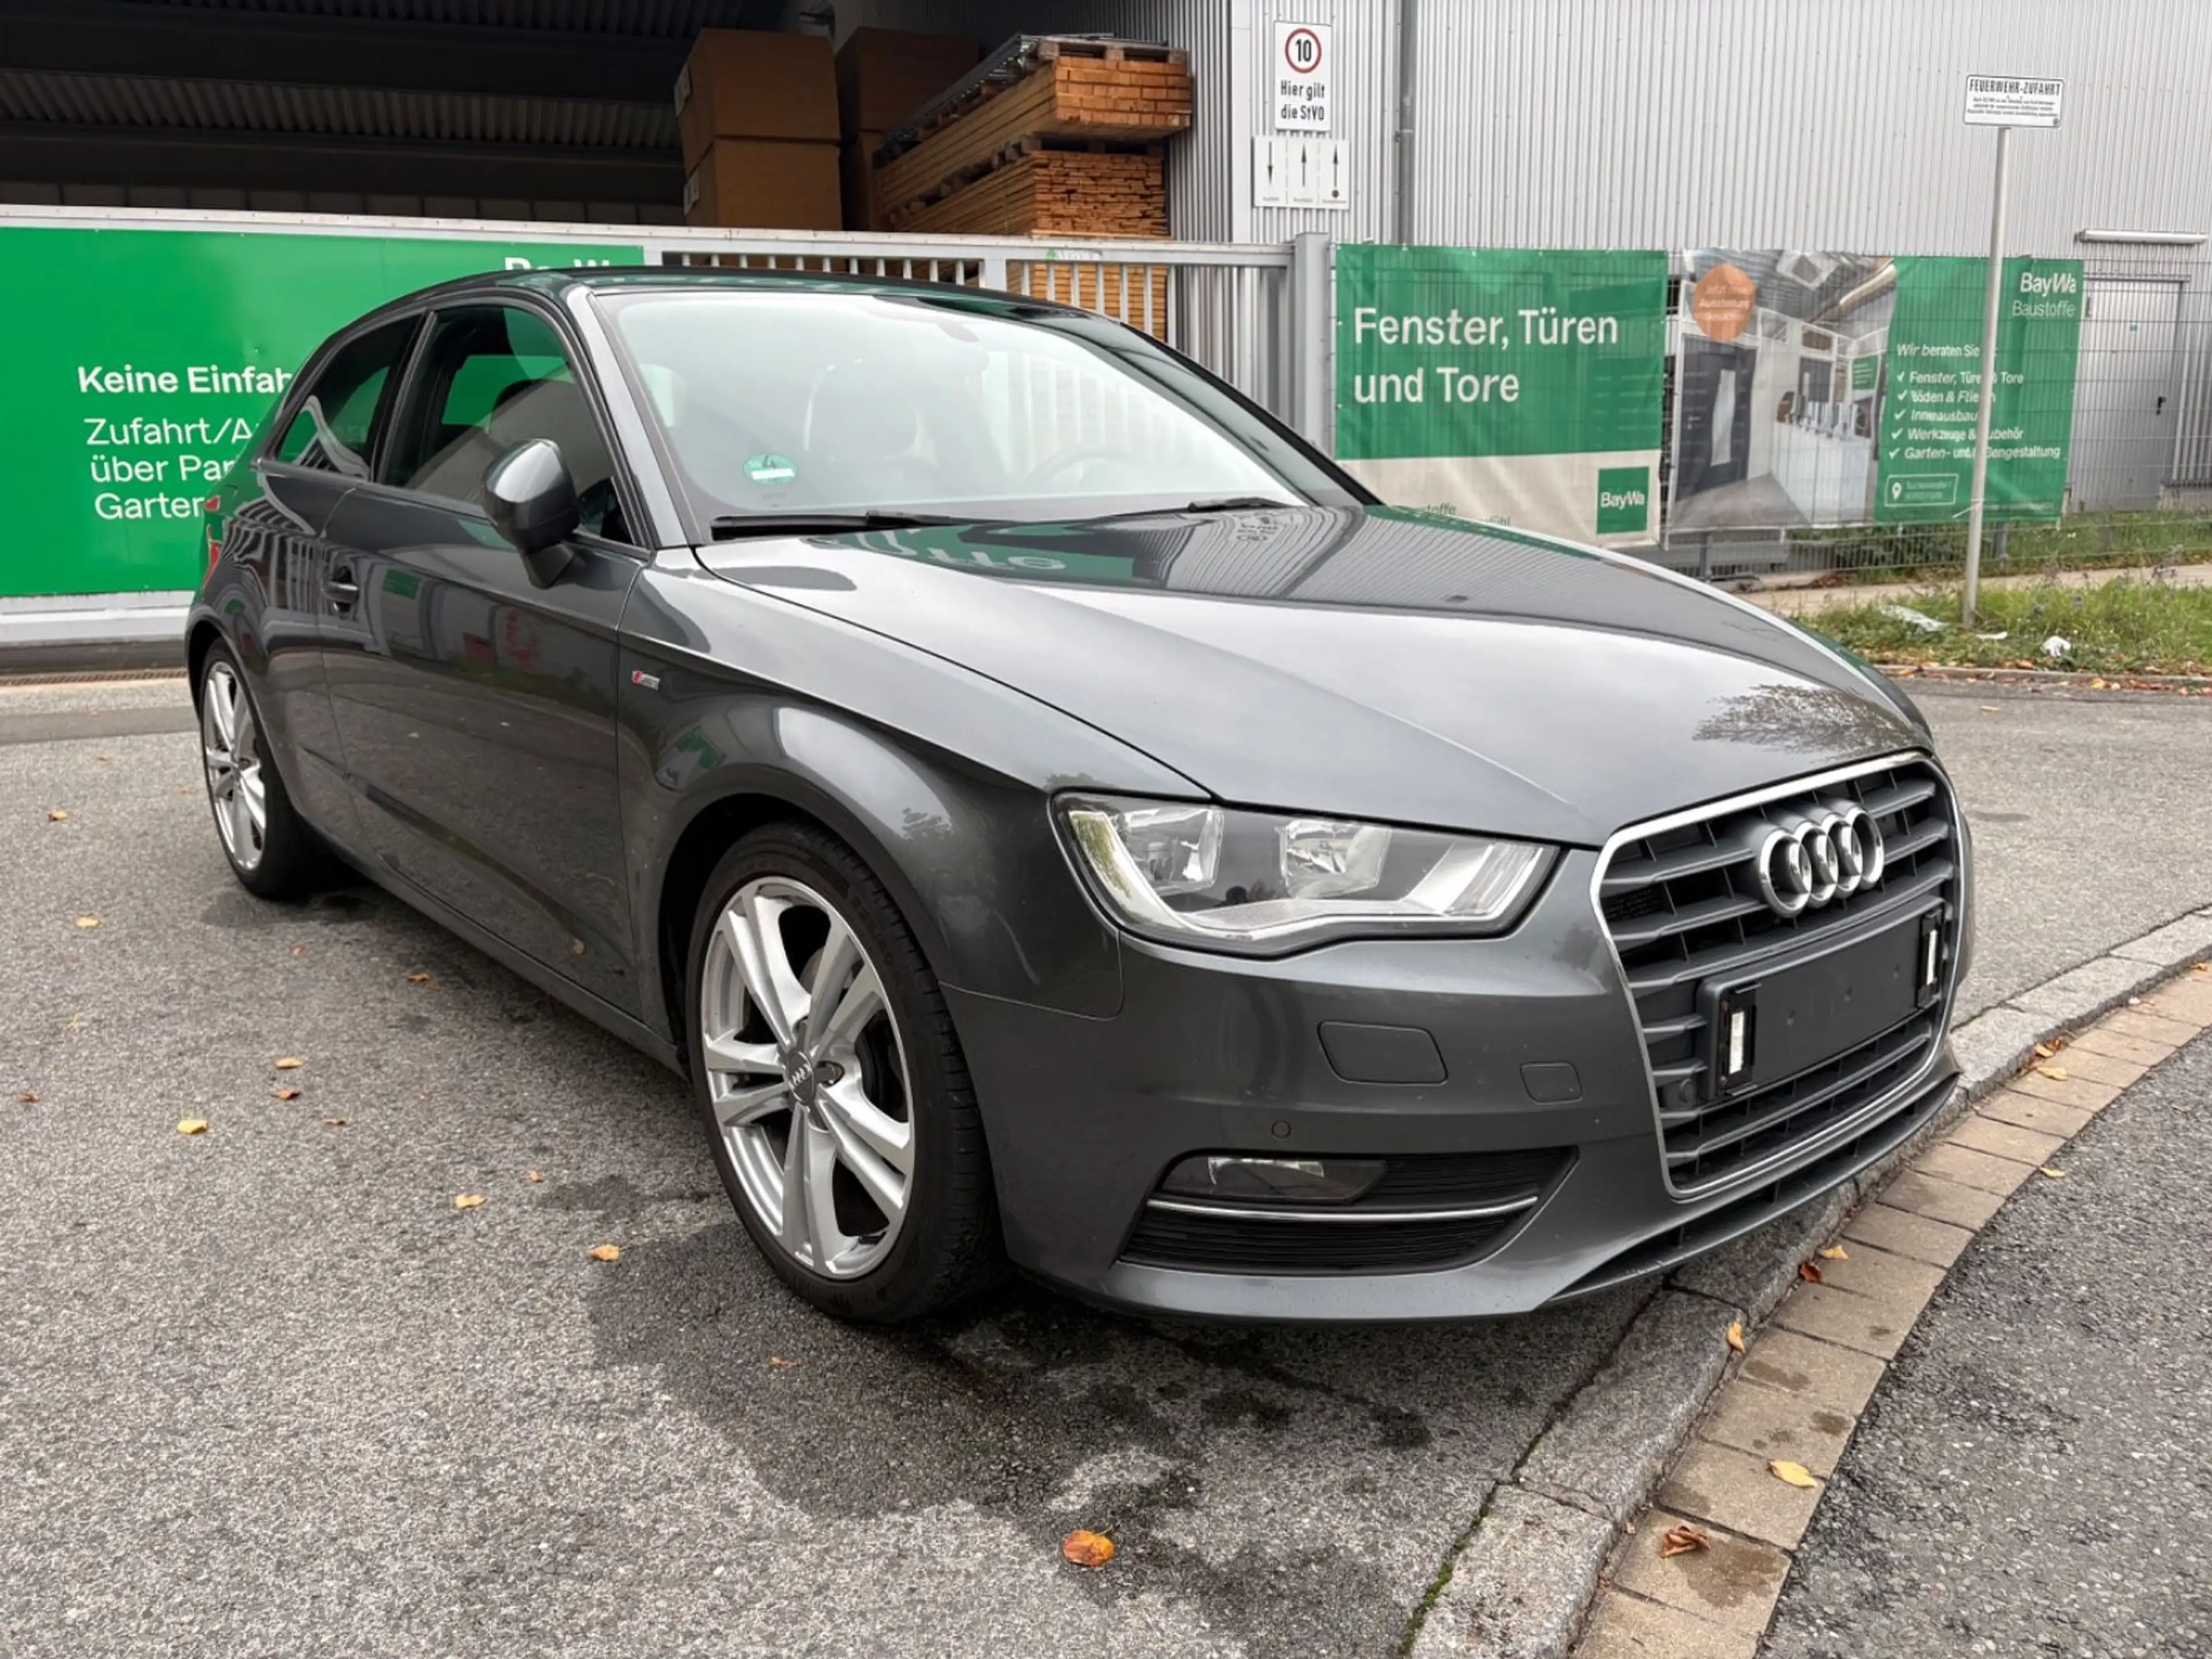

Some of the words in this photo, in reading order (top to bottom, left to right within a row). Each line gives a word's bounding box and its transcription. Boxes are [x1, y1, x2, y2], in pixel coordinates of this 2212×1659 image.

[1296, 39, 1312, 62] 10
[1281, 79, 1304, 97] Hier
[1306, 82, 1325, 101] gilt
[1281, 104, 1298, 119] die
[1300, 105, 1325, 122] StVO
[2020, 272, 2077, 297] BayWa
[2012, 300, 2075, 317] Baustoffe
[1354, 308, 1509, 350] Fenster,
[1518, 307, 1618, 345] Türen
[1897, 343, 1919, 357] Wir
[1922, 344, 1962, 357] beraten
[1963, 344, 1980, 357] Sie
[77, 365, 179, 393] Keine
[1354, 368, 1424, 403] und
[1436, 367, 1520, 403] Tore
[1909, 370, 1957, 389] Fenster,
[1959, 370, 1982, 384] Türe
[2001, 371, 2024, 384] Tore
[1957, 389, 1996, 403] Flien
[84, 418, 259, 445] Zufahrt/A
[1987, 426, 2024, 440] ubehör
[1904, 446, 1952, 460] Garten-
[90, 454, 169, 483] über
[1601, 490, 1645, 510] BayWa
